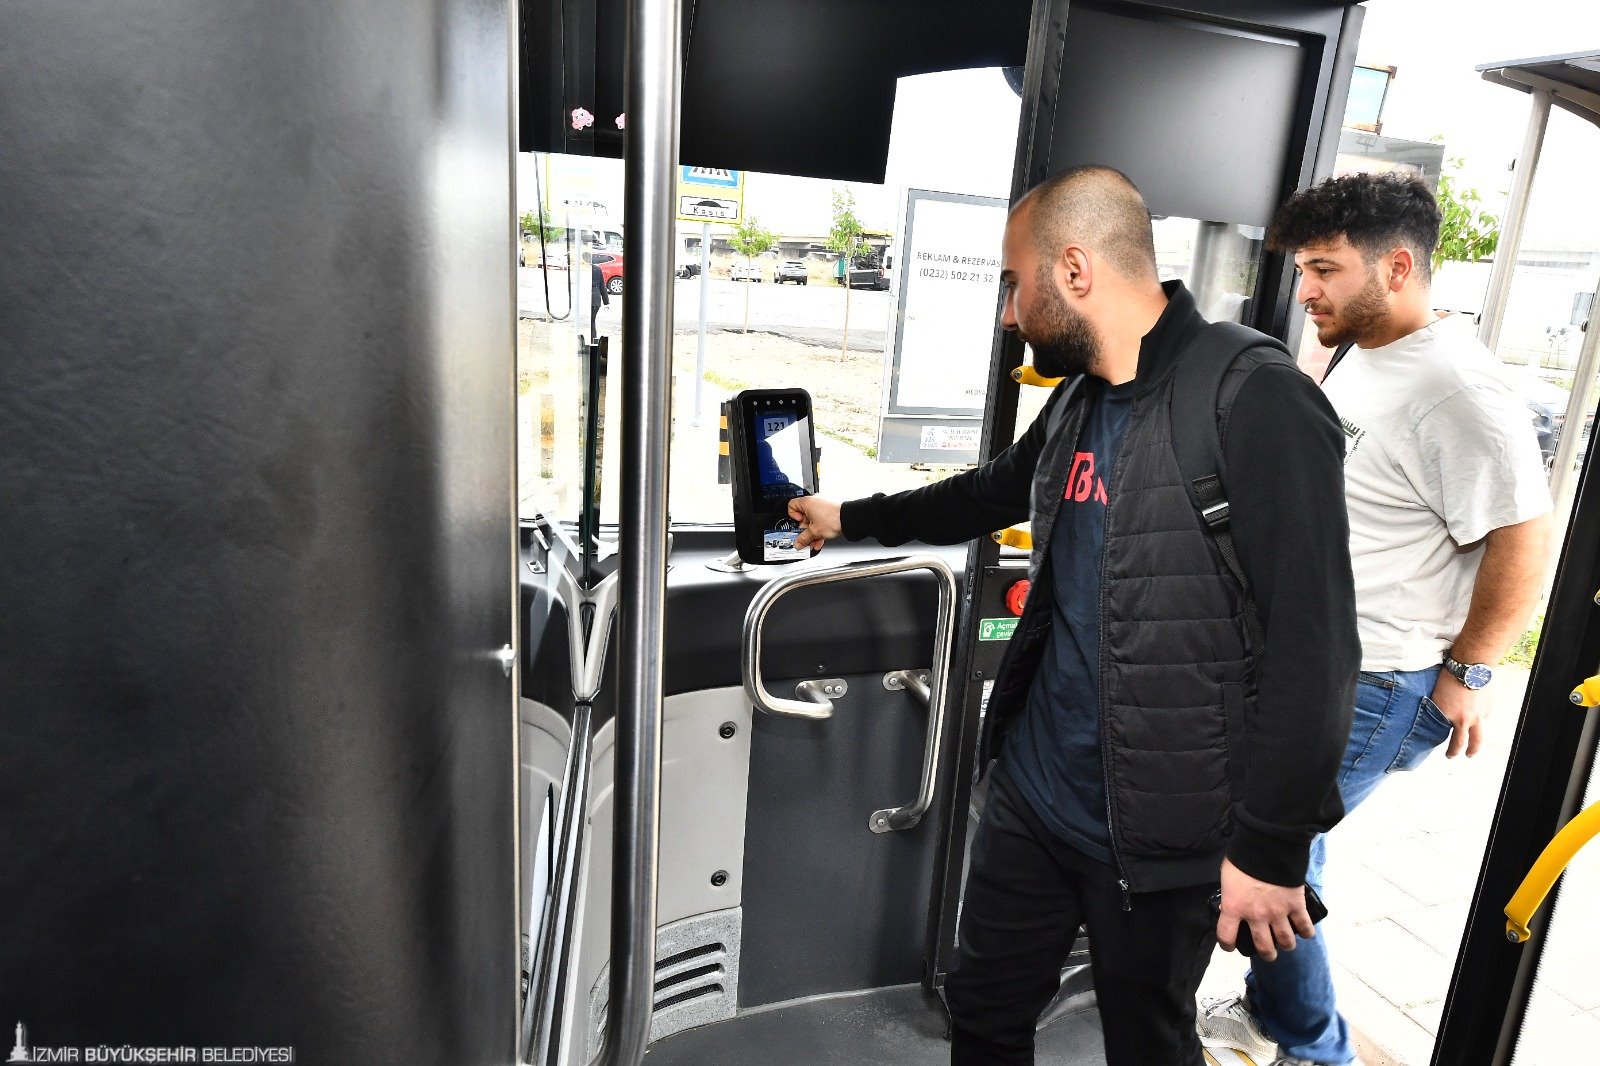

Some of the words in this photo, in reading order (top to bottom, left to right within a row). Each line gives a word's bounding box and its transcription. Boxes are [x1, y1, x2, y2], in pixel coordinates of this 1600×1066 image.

[917, 251, 951, 263] REKLAM
[952, 255, 960, 264] &
[961, 256, 1000, 268] REZERVAS
[919, 267, 948, 280] (0232)
[950, 270, 968, 281] 502
[969, 272, 980, 282] 21
[982, 273, 994, 283] 32
[767, 421, 785, 432] 121
